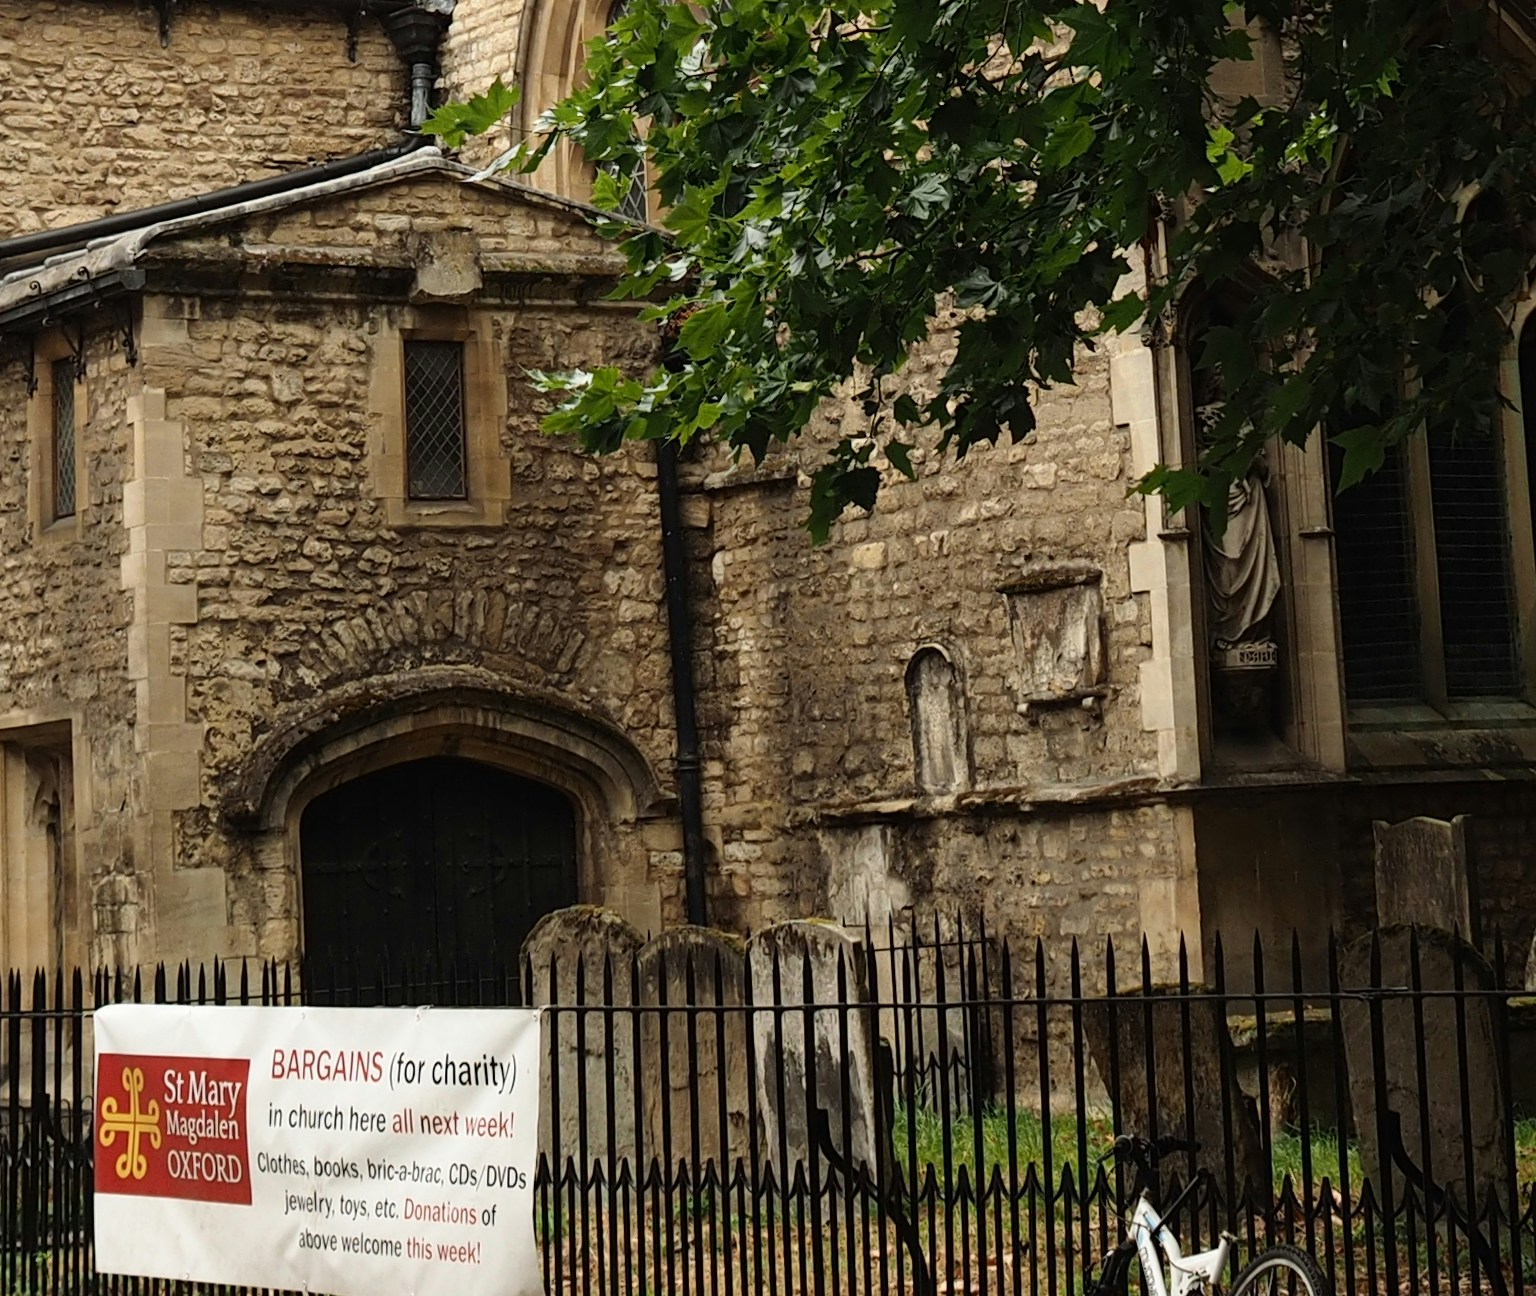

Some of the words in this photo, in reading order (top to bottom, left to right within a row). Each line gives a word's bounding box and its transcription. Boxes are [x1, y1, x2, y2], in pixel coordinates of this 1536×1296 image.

[271, 1049, 383, 1083] BARGAINS
[389, 1052, 425, 1091] (for
[432, 1053, 516, 1094] charity)
[163, 1069, 184, 1104] St
[187, 1070, 242, 1119] Mary
[166, 1109, 240, 1145] Magdalen
[268, 1102, 283, 1127] in
[288, 1104, 343, 1130] church
[349, 1106, 386, 1132] here
[392, 1108, 414, 1135] all
[420, 1110, 459, 1135] next
[465, 1111, 515, 1138] week!
[167, 1149, 242, 1183] OXFORD
[257, 1152, 309, 1178] Clothes,
[314, 1155, 363, 1181] books,
[367, 1158, 444, 1186] bric-a-brac,
[449, 1163, 526, 1191] CDs/DVDs
[284, 1190, 335, 1219] jewelry,
[340, 1195, 370, 1221] toys,
[375, 1198, 399, 1219] etc.
[404, 1198, 477, 1225] Donations
[481, 1204, 497, 1226] of
[298, 1228, 338, 1251] above
[341, 1232, 402, 1257] welcome
[406, 1237, 433, 1260] this
[437, 1241, 481, 1264] week!
